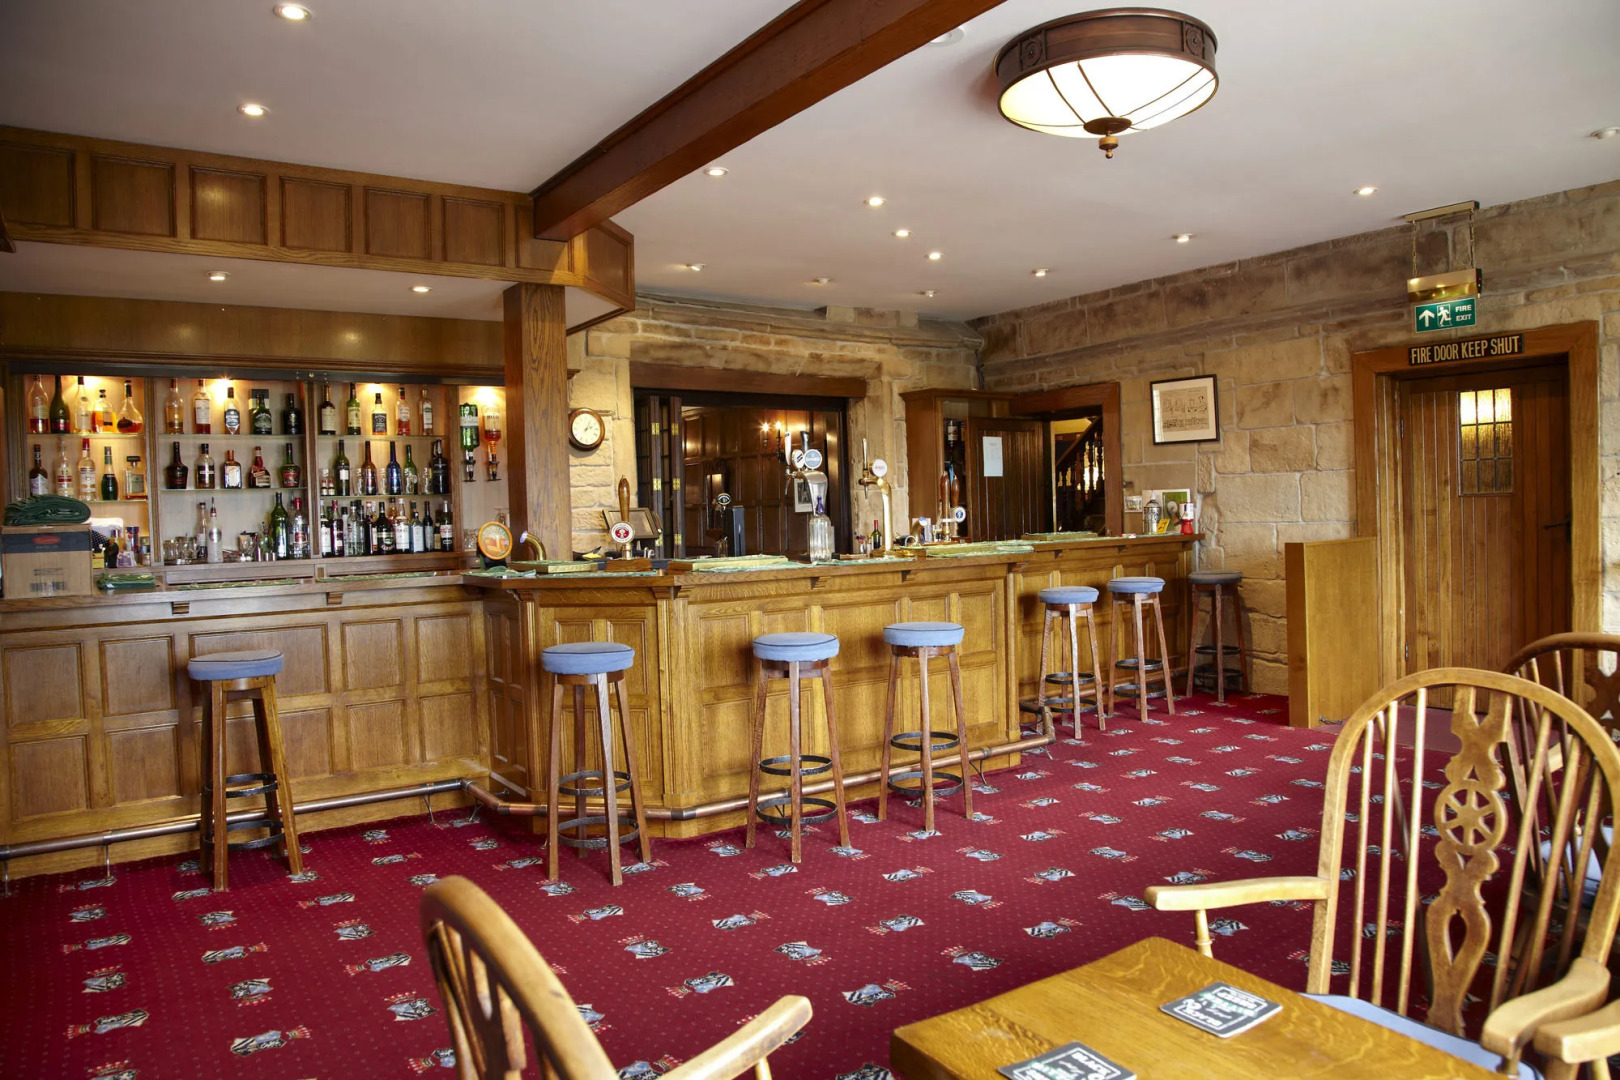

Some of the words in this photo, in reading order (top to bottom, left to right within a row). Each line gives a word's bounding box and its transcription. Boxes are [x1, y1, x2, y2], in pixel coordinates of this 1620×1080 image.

[1411, 347, 1432, 364] FIRE
[1434, 343, 1459, 361] DOOR
[1461, 340, 1488, 358] KEEP
[1490, 336, 1520, 355] SHUT
